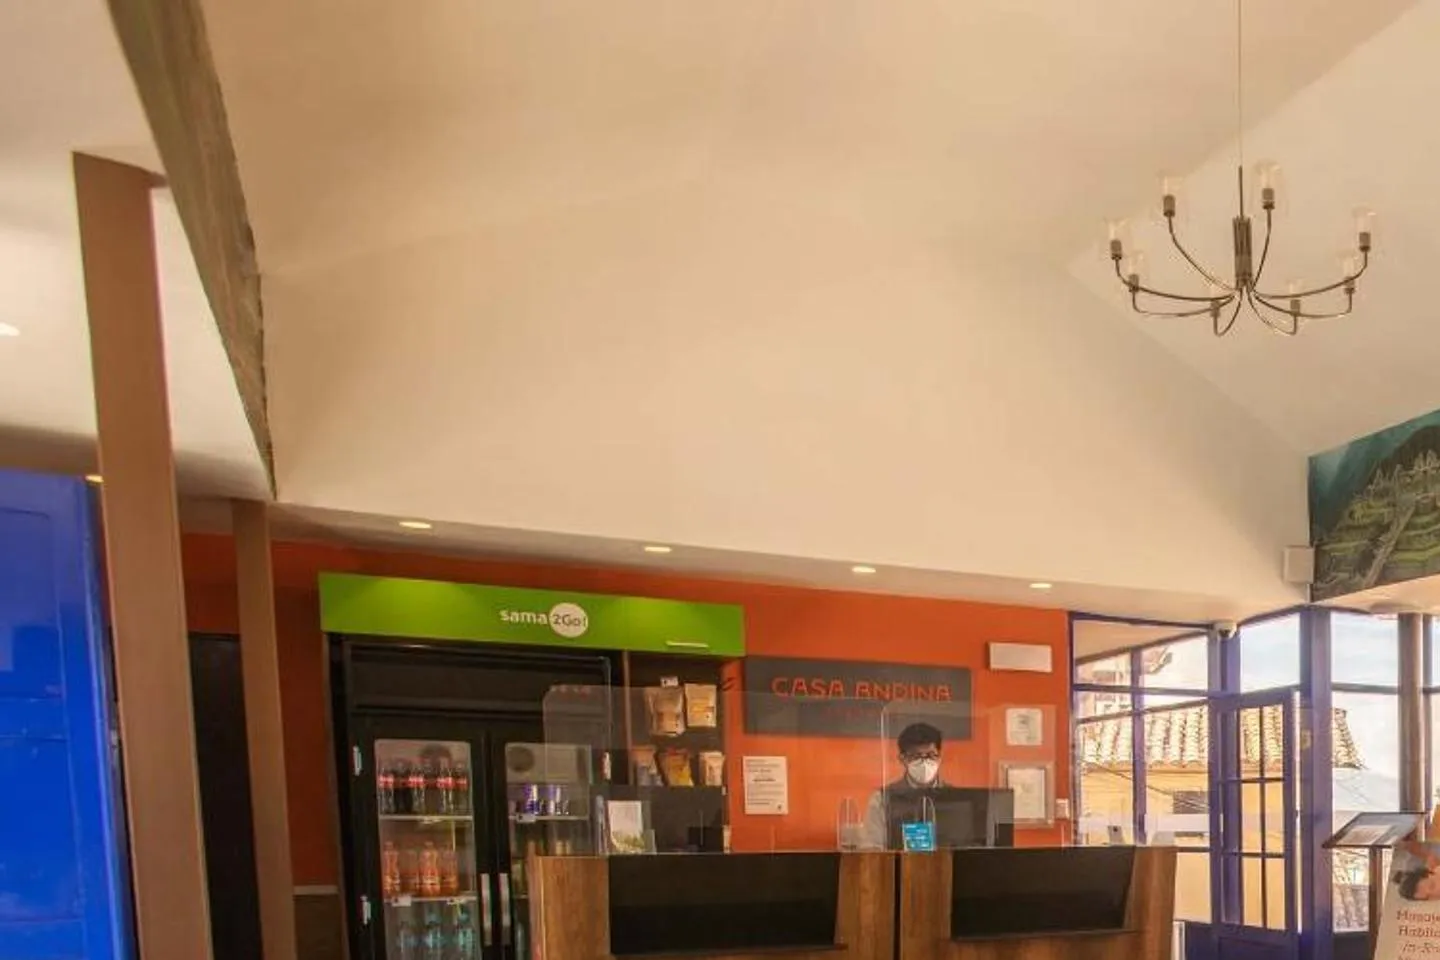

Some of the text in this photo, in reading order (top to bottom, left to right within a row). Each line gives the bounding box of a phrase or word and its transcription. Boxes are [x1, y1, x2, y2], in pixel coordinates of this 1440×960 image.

[499, 609, 548, 625] sama
[771, 676, 953, 703] CASA ANDINA
